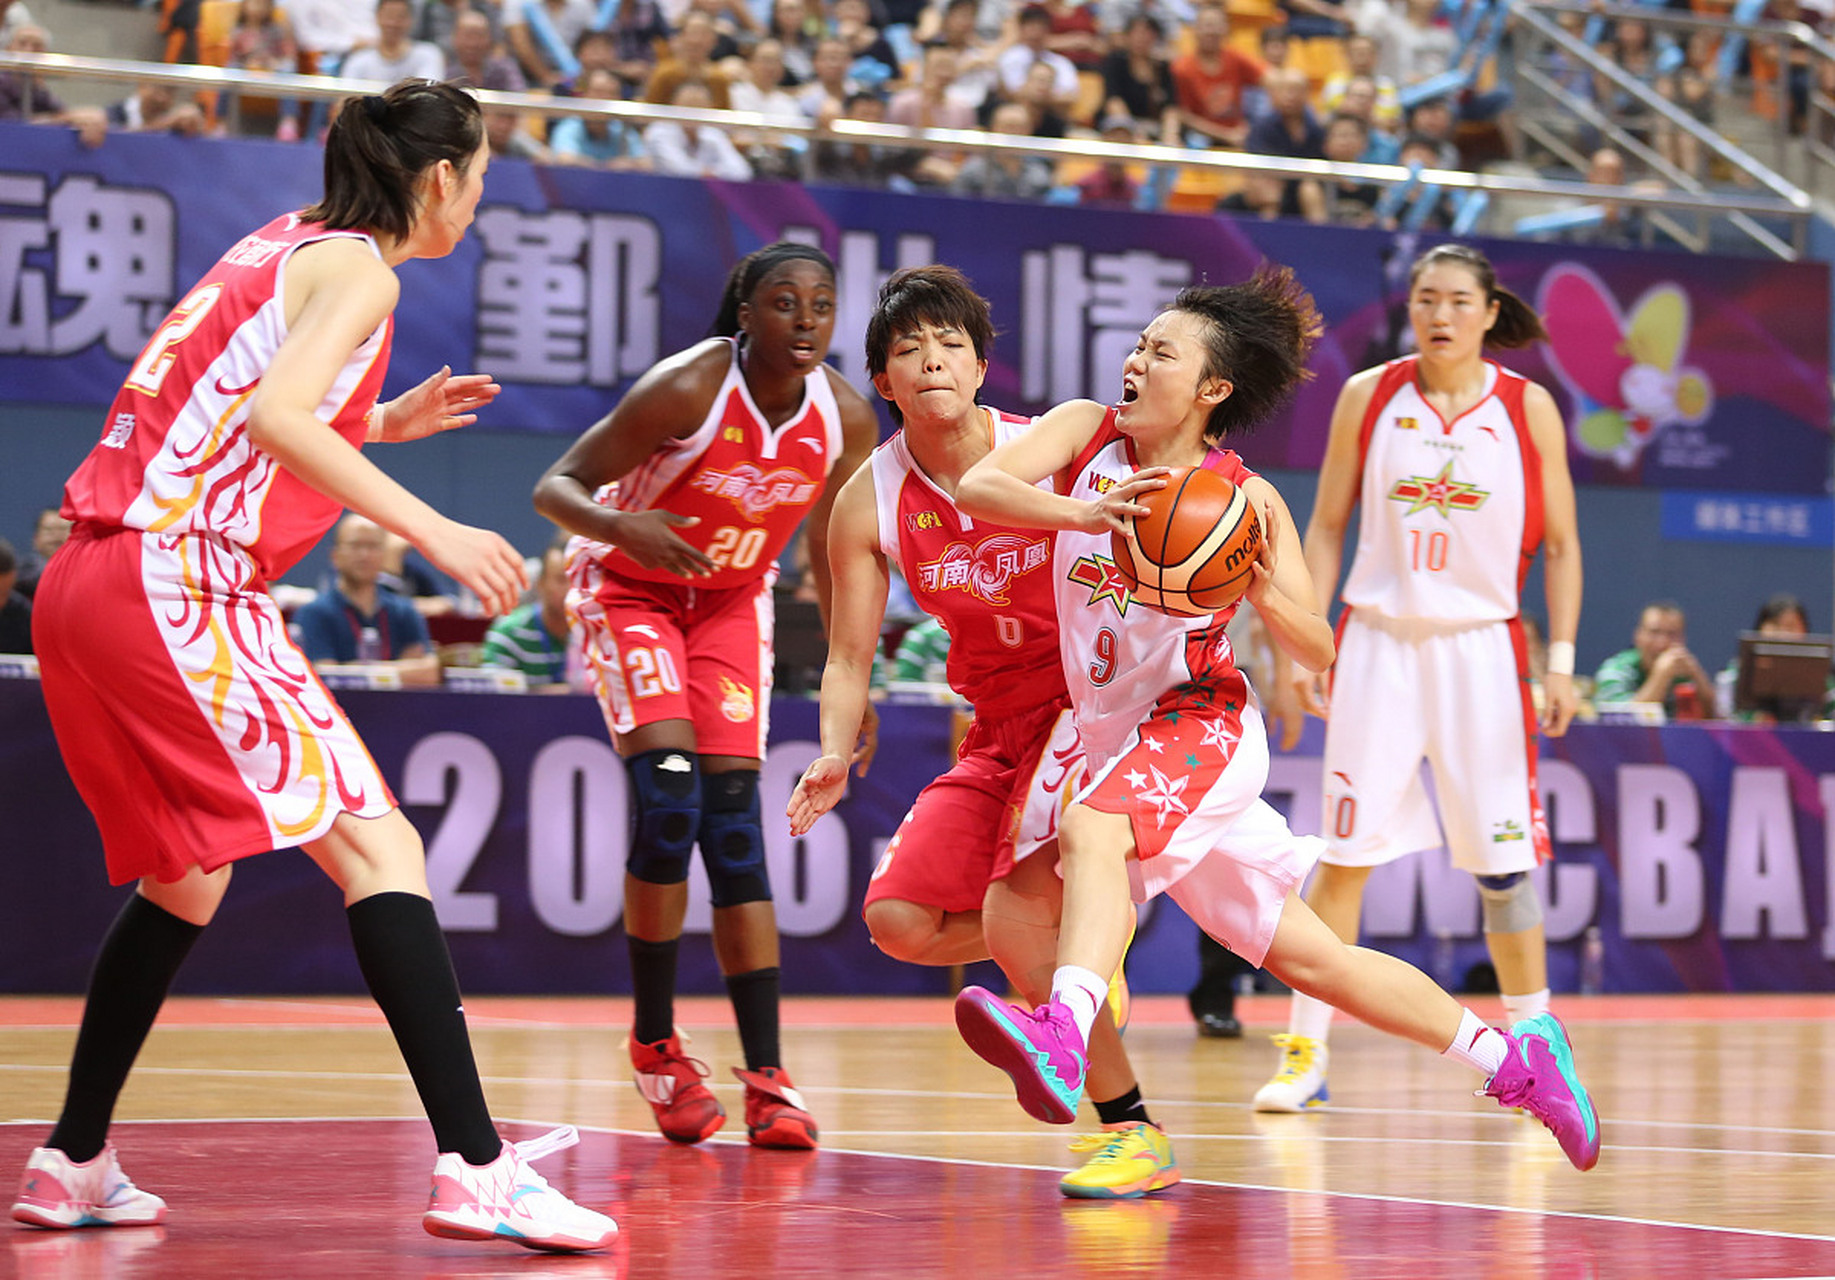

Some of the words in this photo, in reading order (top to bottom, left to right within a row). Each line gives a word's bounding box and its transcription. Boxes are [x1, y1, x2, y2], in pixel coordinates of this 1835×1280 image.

[124, 282, 225, 398] 2
[706, 526, 769, 570] 20
[917, 540, 1049, 592] 河南凤凰
[1408, 529, 1449, 573] 10
[626, 646, 682, 699] 20
[1087, 626, 1119, 688] 9
